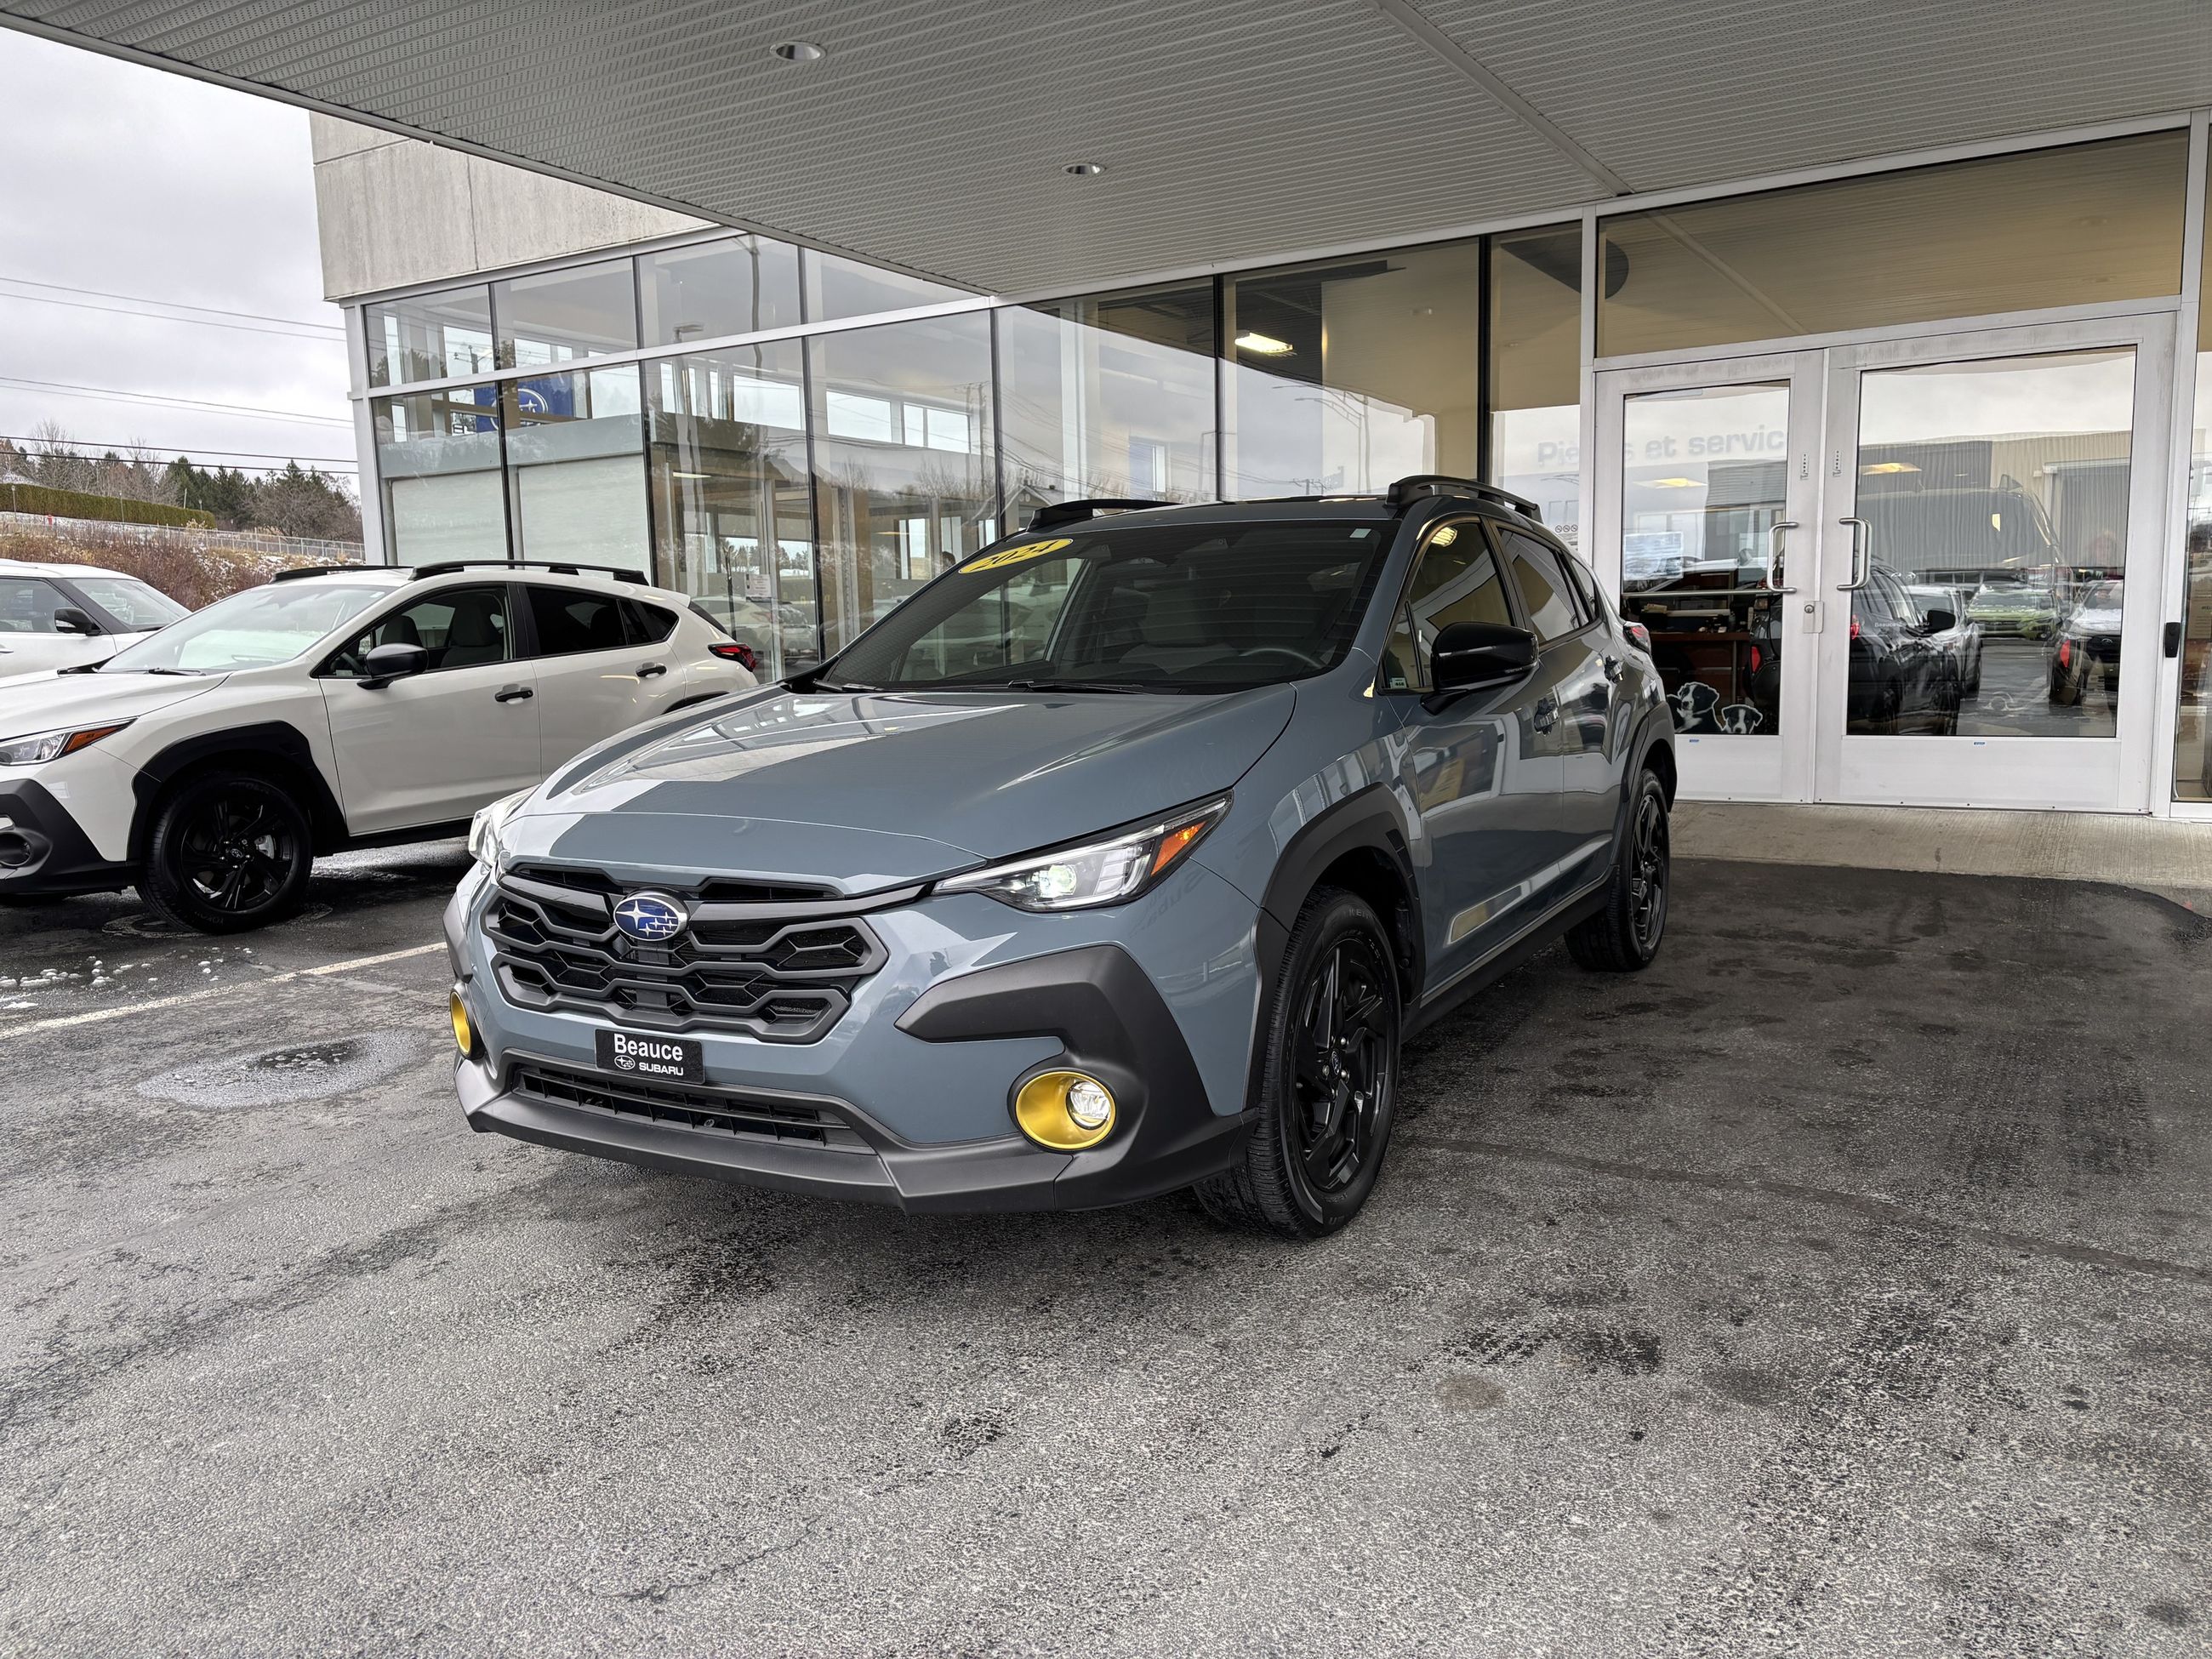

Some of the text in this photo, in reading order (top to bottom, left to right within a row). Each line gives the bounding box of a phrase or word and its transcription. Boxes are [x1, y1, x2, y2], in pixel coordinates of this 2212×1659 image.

[1645, 435, 1676, 459] et
[613, 1033, 683, 1062] Beauce
[639, 1062, 684, 1076] SUBARU
